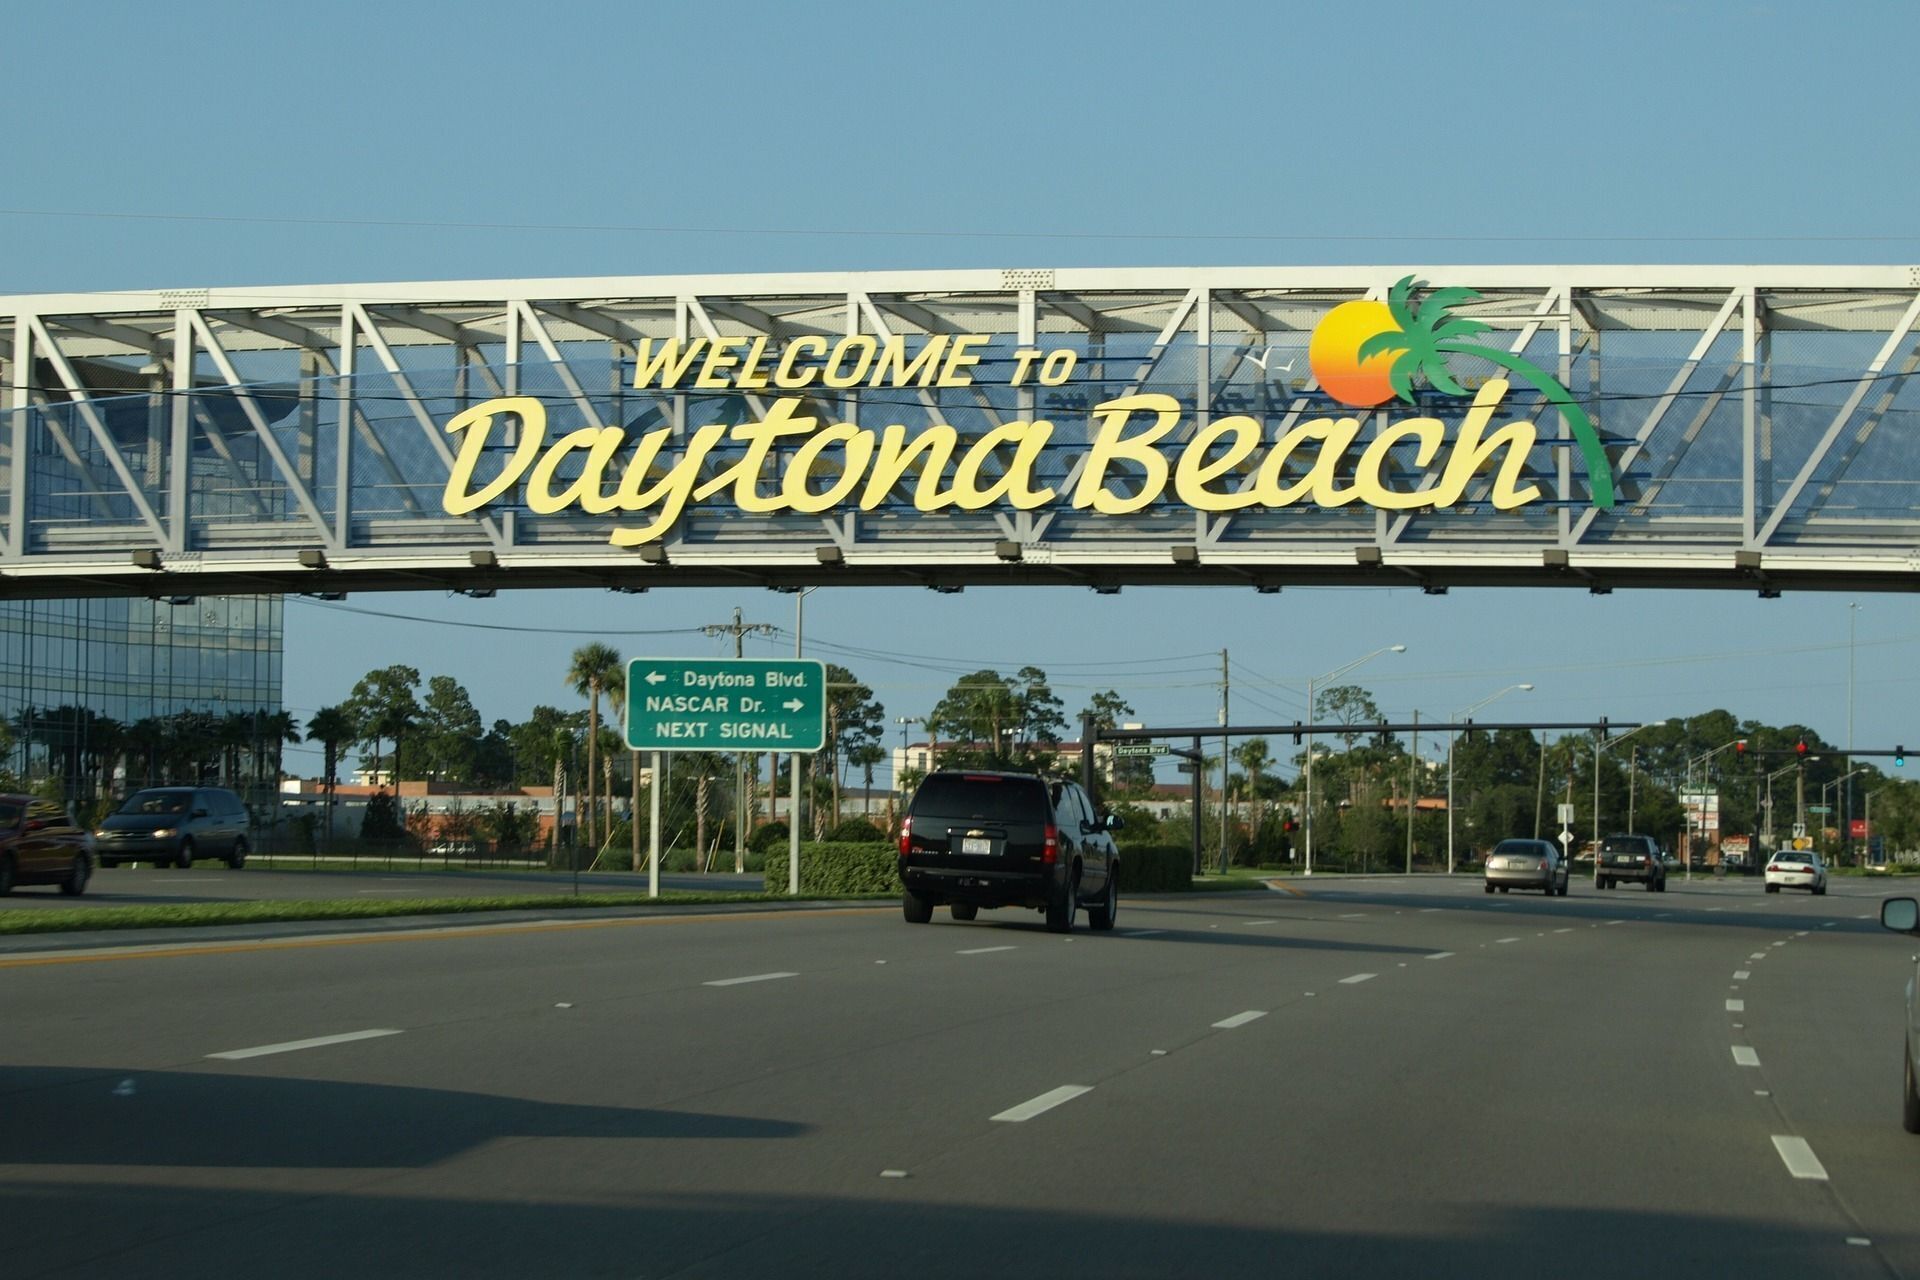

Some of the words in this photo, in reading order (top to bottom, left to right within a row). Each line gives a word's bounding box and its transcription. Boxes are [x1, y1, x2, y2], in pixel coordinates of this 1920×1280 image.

[633, 335, 990, 389] WELCOME
[1012, 350, 1077, 386] TO
[442, 396, 1056, 546] Daytona
[1072, 379, 1541, 516] Beach
[683, 671, 755, 690] Daytona
[765, 671, 807, 687] Blvd.
[646, 696, 729, 713] NASCAR
[740, 697, 766, 713] Dr.
[656, 722, 708, 738] NEXT
[719, 723, 793, 739] SIGNAL
[1118, 747, 1148, 755] Daytona
